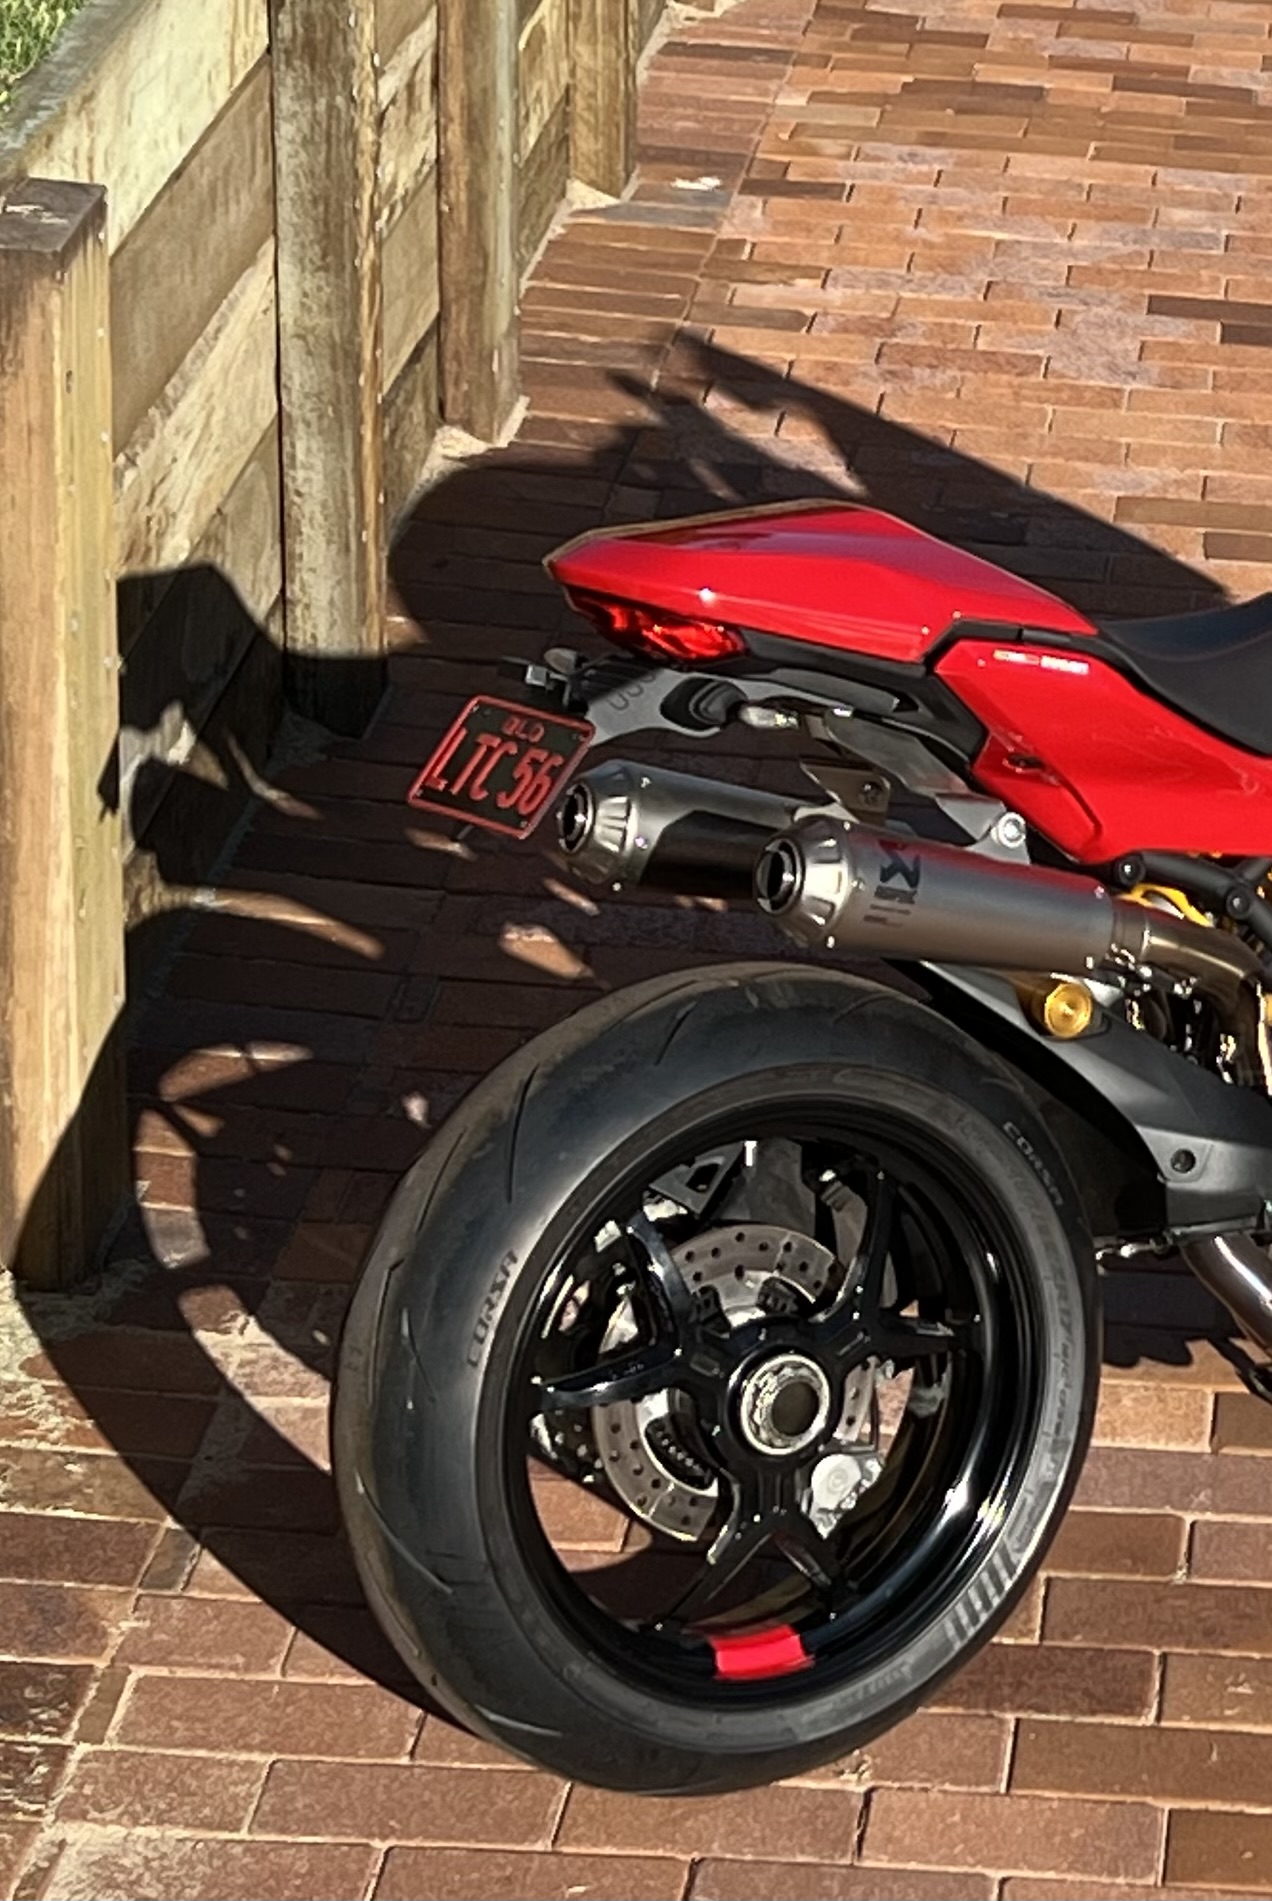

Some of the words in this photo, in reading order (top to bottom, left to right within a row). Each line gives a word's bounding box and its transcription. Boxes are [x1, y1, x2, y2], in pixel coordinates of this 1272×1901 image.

[424, 727, 518, 800] LTC
[496, 748, 564, 815] 56
[502, 716, 545, 742] QLD
[466, 1249, 518, 1368] CORSA
